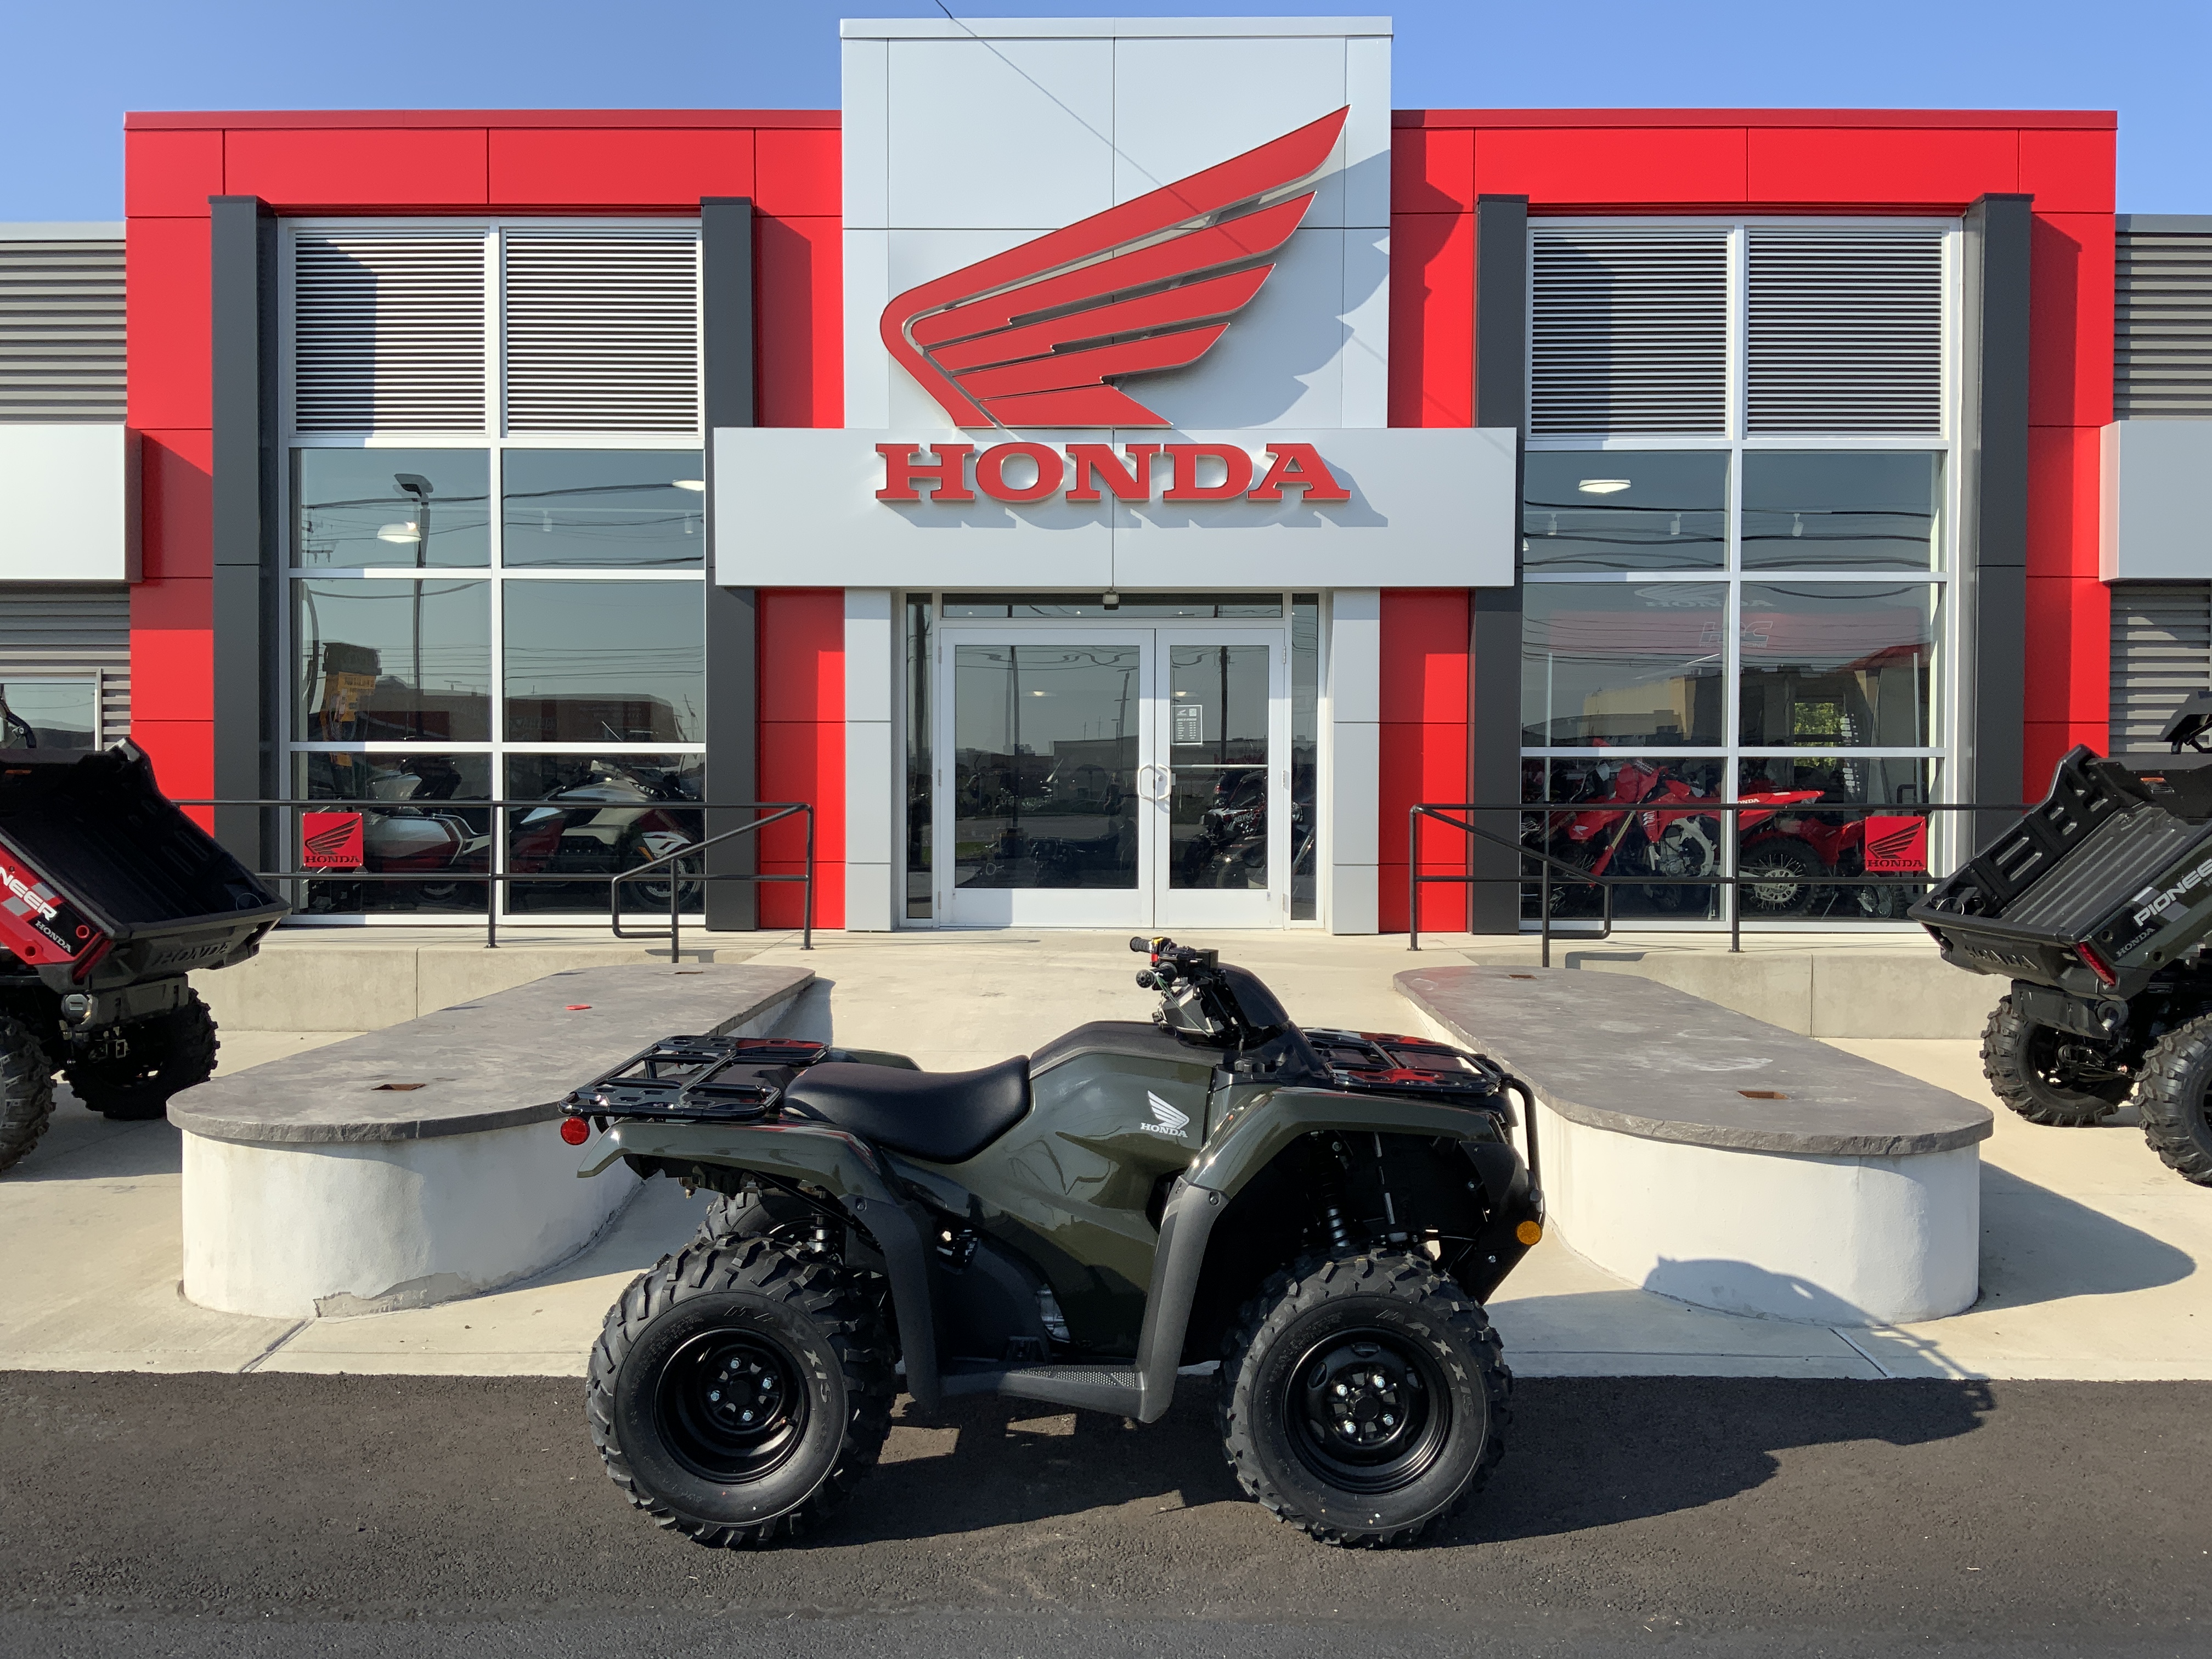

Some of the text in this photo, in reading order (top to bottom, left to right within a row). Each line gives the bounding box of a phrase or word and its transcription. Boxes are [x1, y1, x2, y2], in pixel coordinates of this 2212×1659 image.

[875, 442, 1351, 503] HONDA
[35, 920, 71, 952] HONDA
[2116, 928, 2156, 957] HONDA
[152, 940, 232, 966] HONDA
[1141, 1122, 1188, 1138] HONDA
